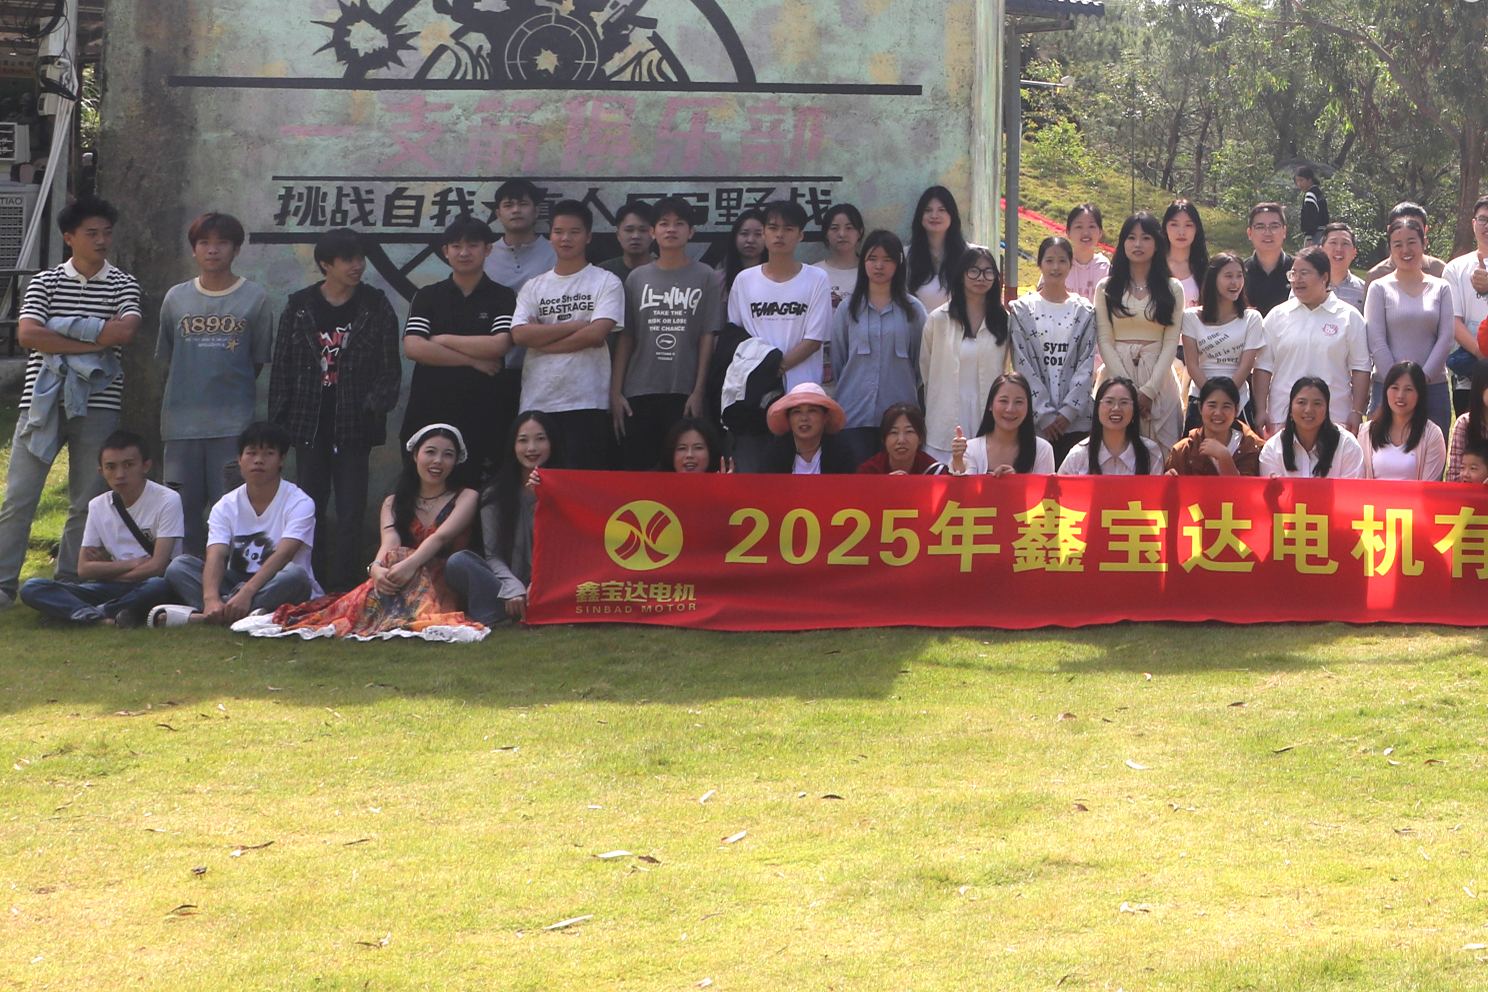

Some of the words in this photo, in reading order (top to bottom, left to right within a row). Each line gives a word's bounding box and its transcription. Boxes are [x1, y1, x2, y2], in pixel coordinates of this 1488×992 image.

[1215, 333, 1230, 345] and
[1207, 351, 1222, 359] that
[575, 581, 697, 603] 鑫宝达电机
[575, 606, 633, 614] SINBAD
[641, 603, 697, 613] MOTOR
